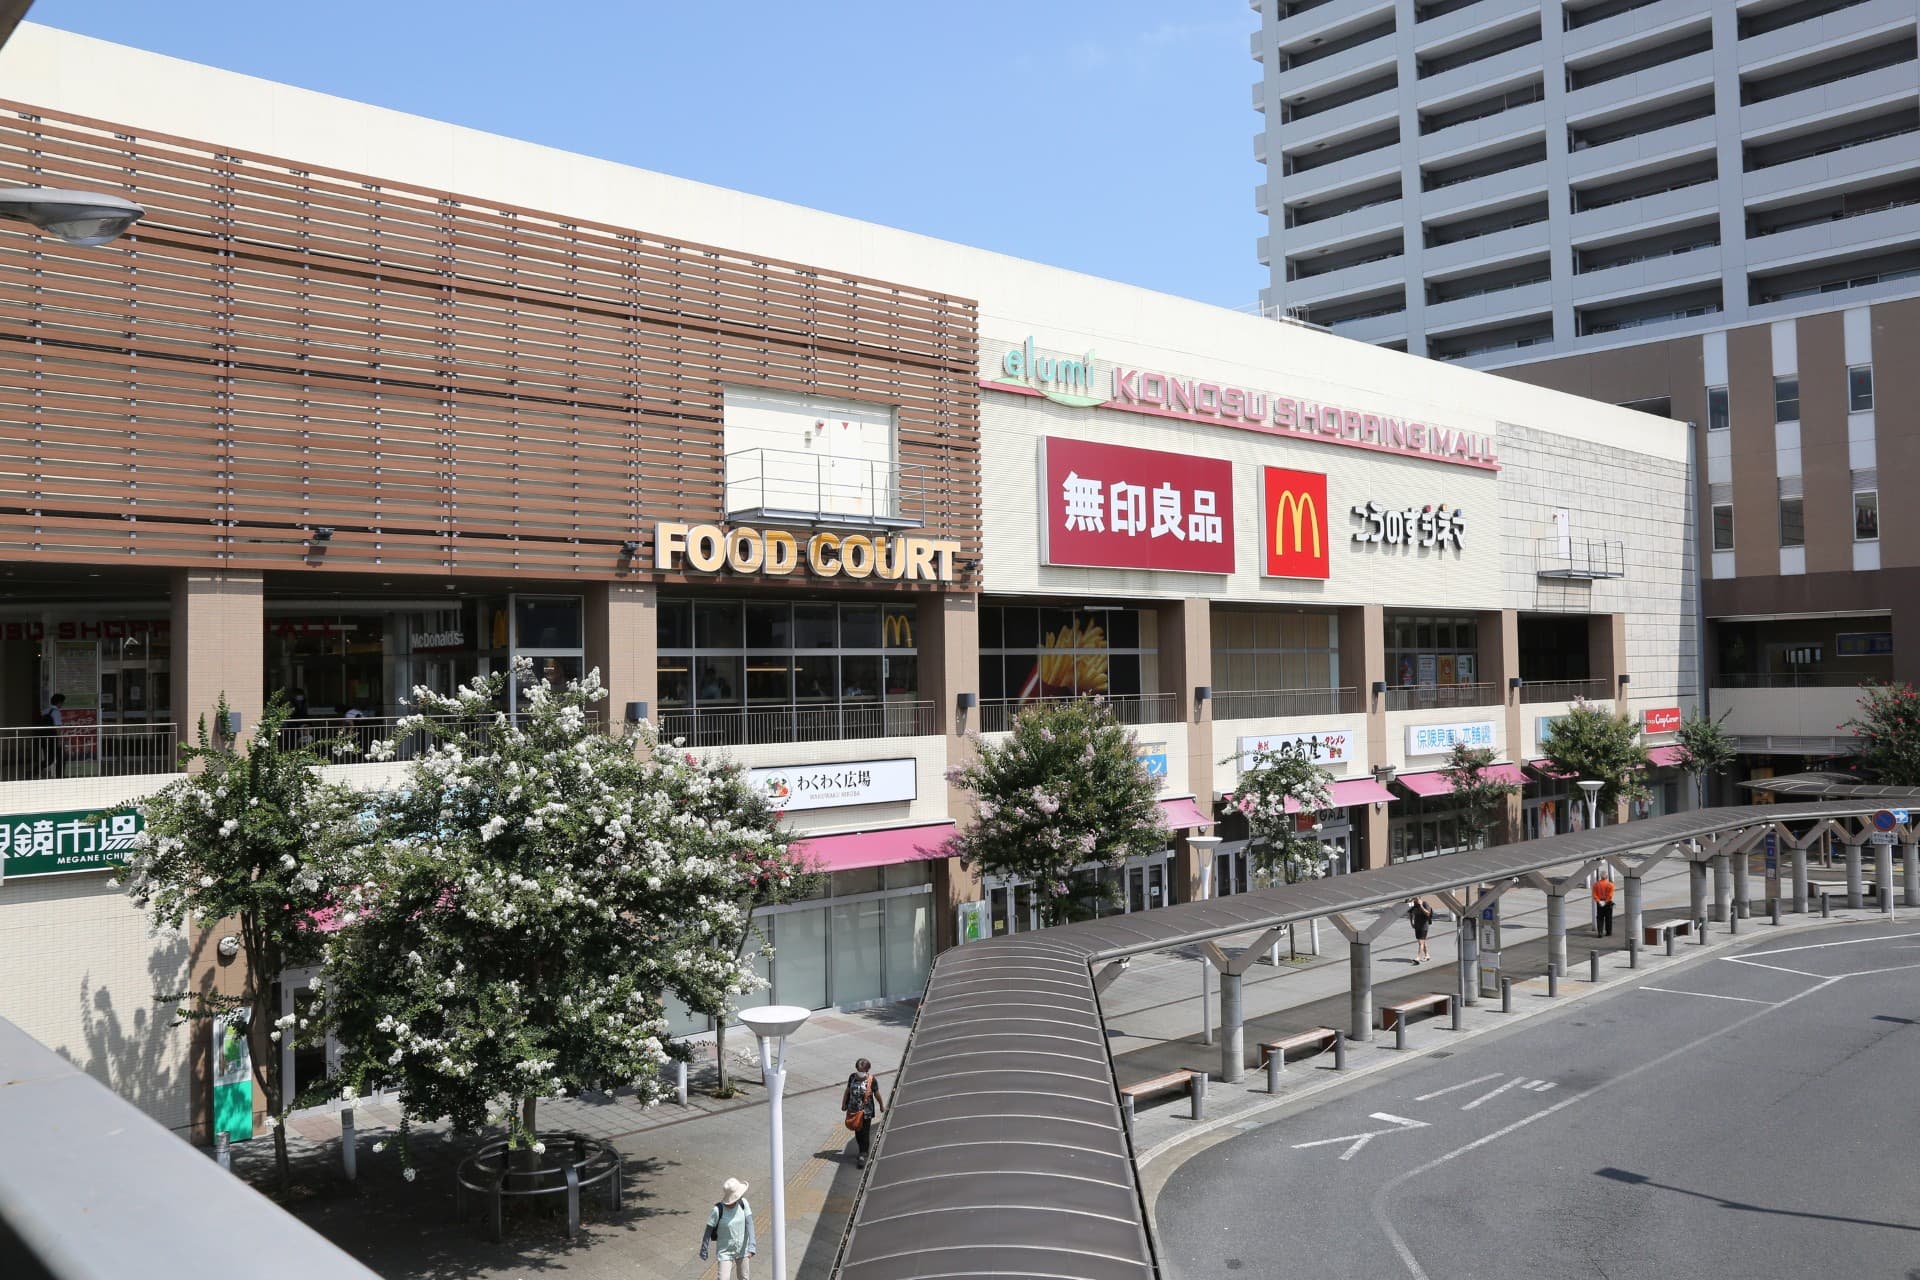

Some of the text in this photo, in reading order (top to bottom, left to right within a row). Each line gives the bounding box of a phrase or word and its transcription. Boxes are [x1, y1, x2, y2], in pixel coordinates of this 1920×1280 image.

[1003, 335, 1096, 388] elumi
[1112, 367, 1498, 464] KONOSU SHOPPING MALL
[1062, 471, 1223, 544] 無印良品
[1350, 501, 1466, 550] こうのすシネマ
[655, 522, 961, 582] FOOD COURT
[797, 770, 871, 791] わくわく広場
[57, 852, 127, 865] MEGANE ICHI
